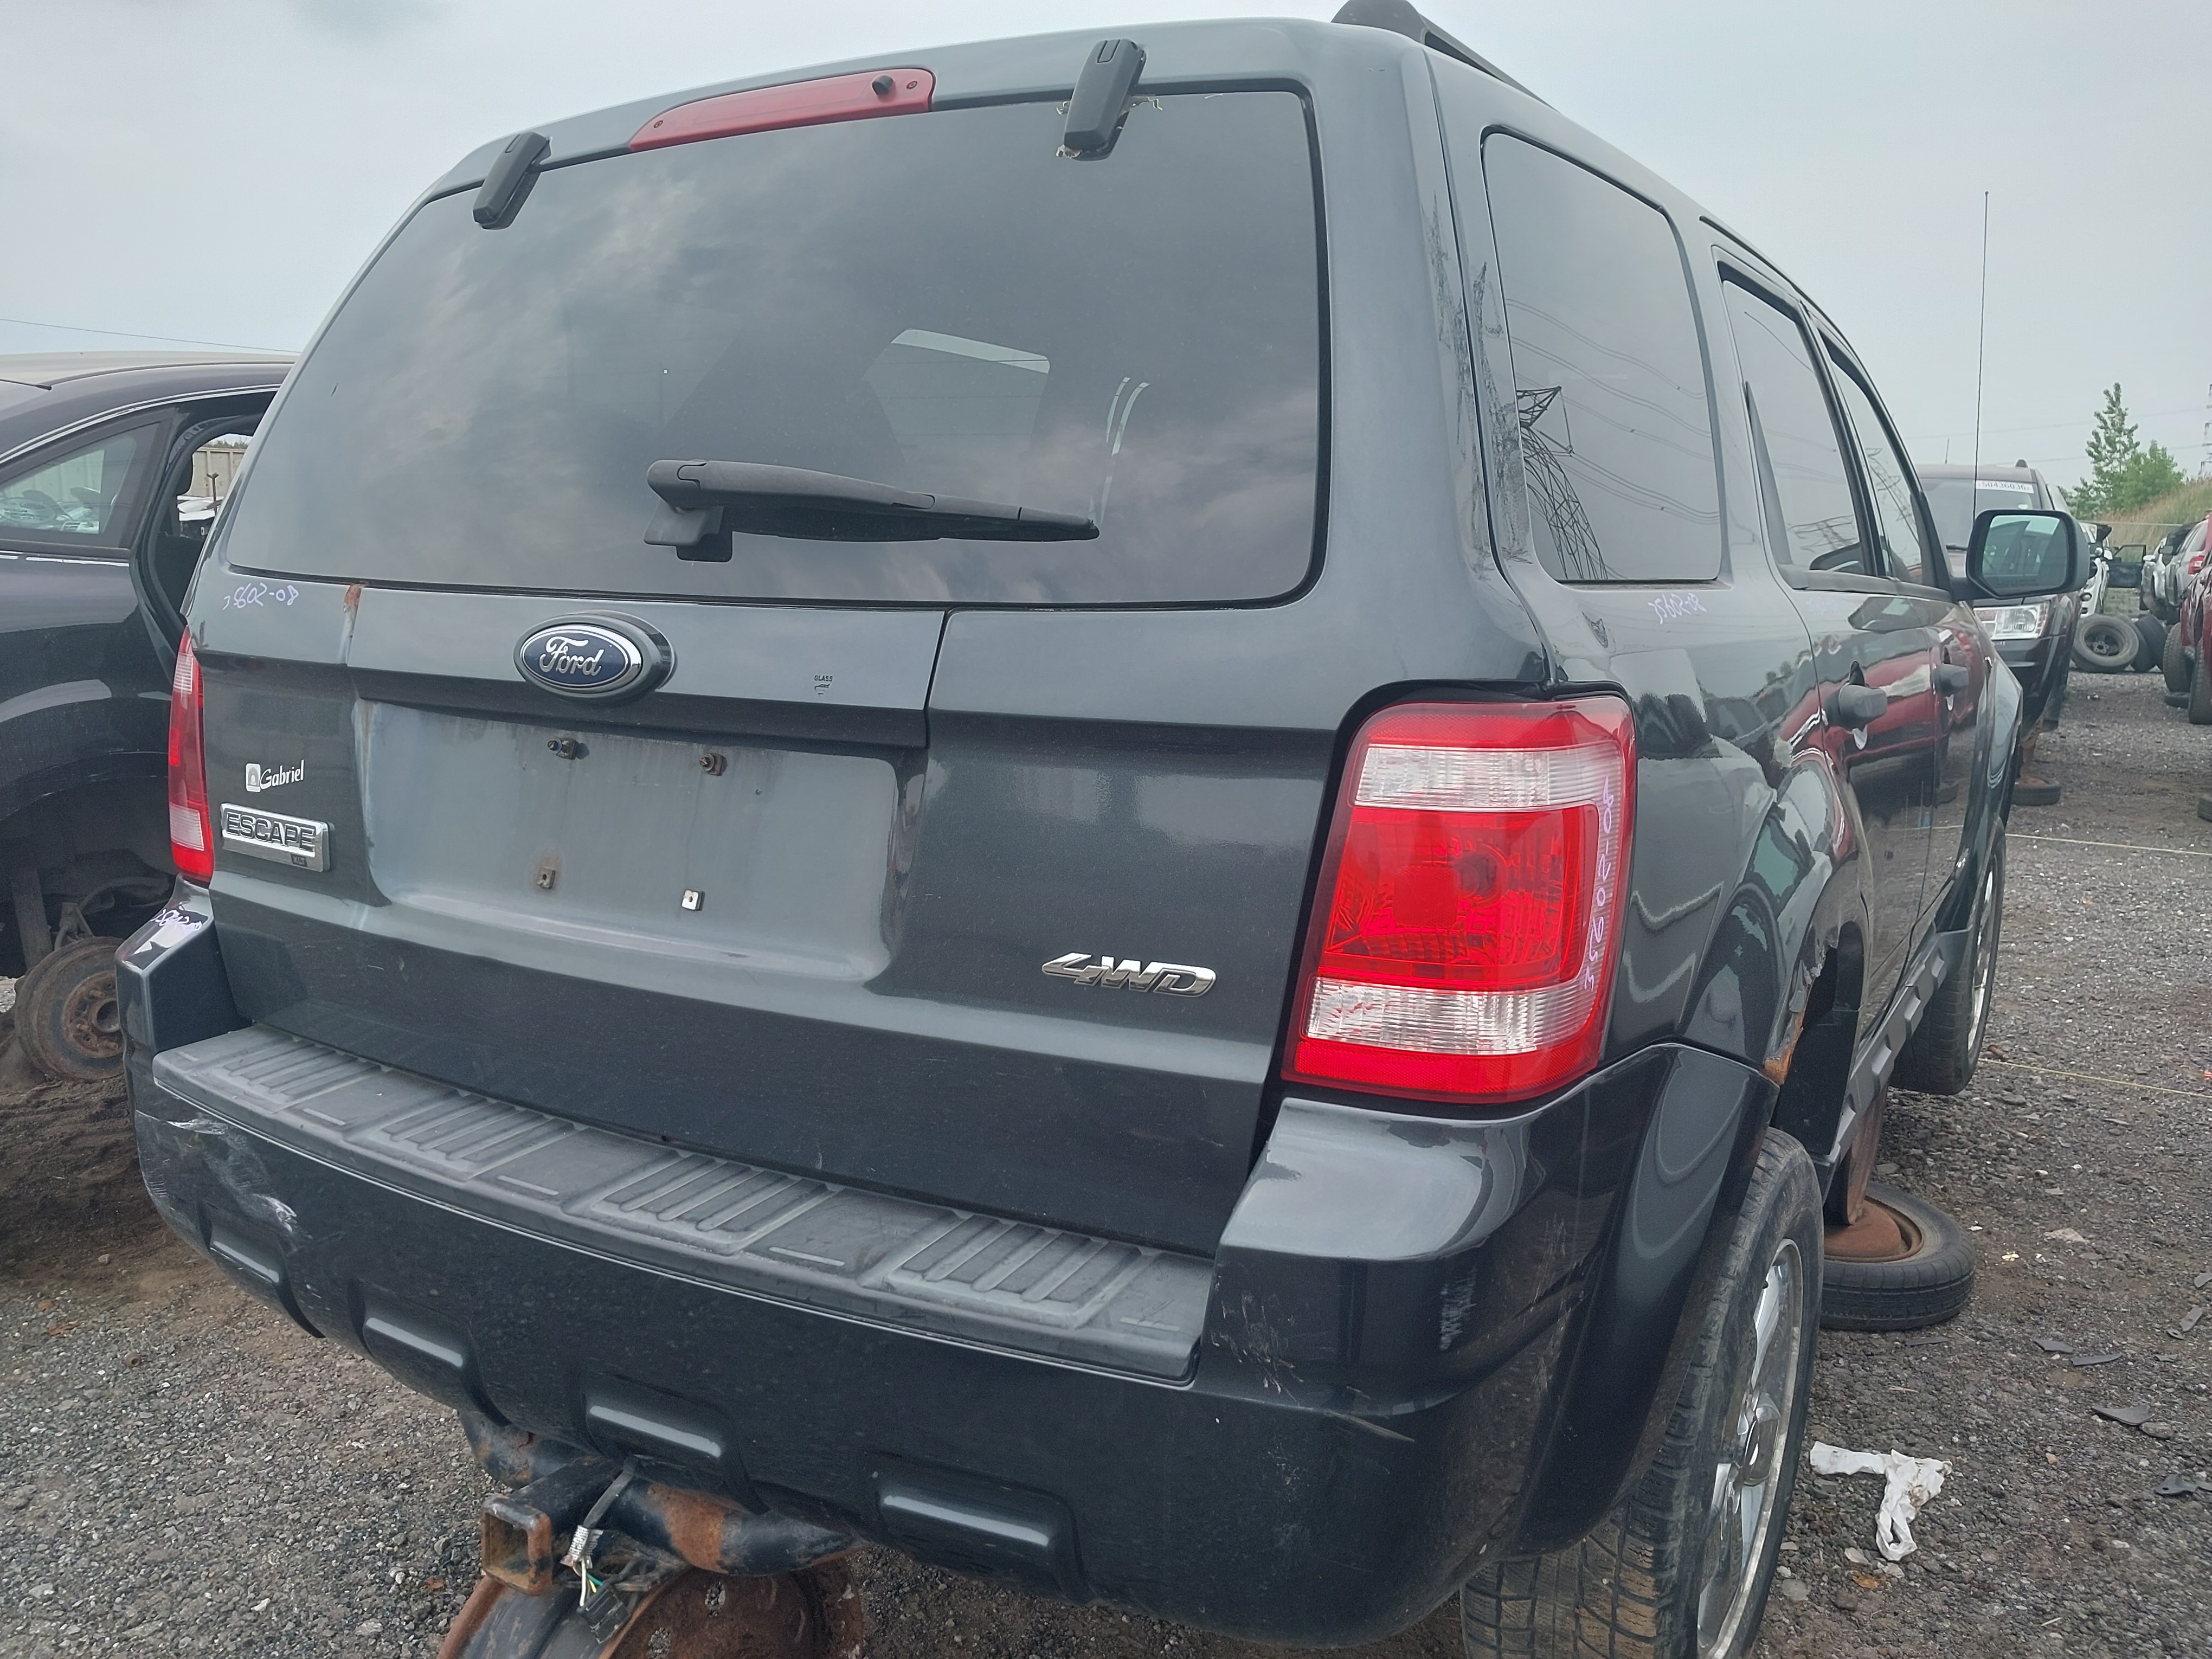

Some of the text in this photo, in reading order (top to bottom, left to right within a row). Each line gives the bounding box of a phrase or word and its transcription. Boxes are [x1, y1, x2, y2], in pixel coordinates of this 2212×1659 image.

[539, 636, 605, 676] Ford
[259, 760, 304, 789] Gabriel
[227, 812, 316, 853] ESCAPE
[292, 856, 305, 866] XLT
[1041, 953, 1216, 998] 4WD
